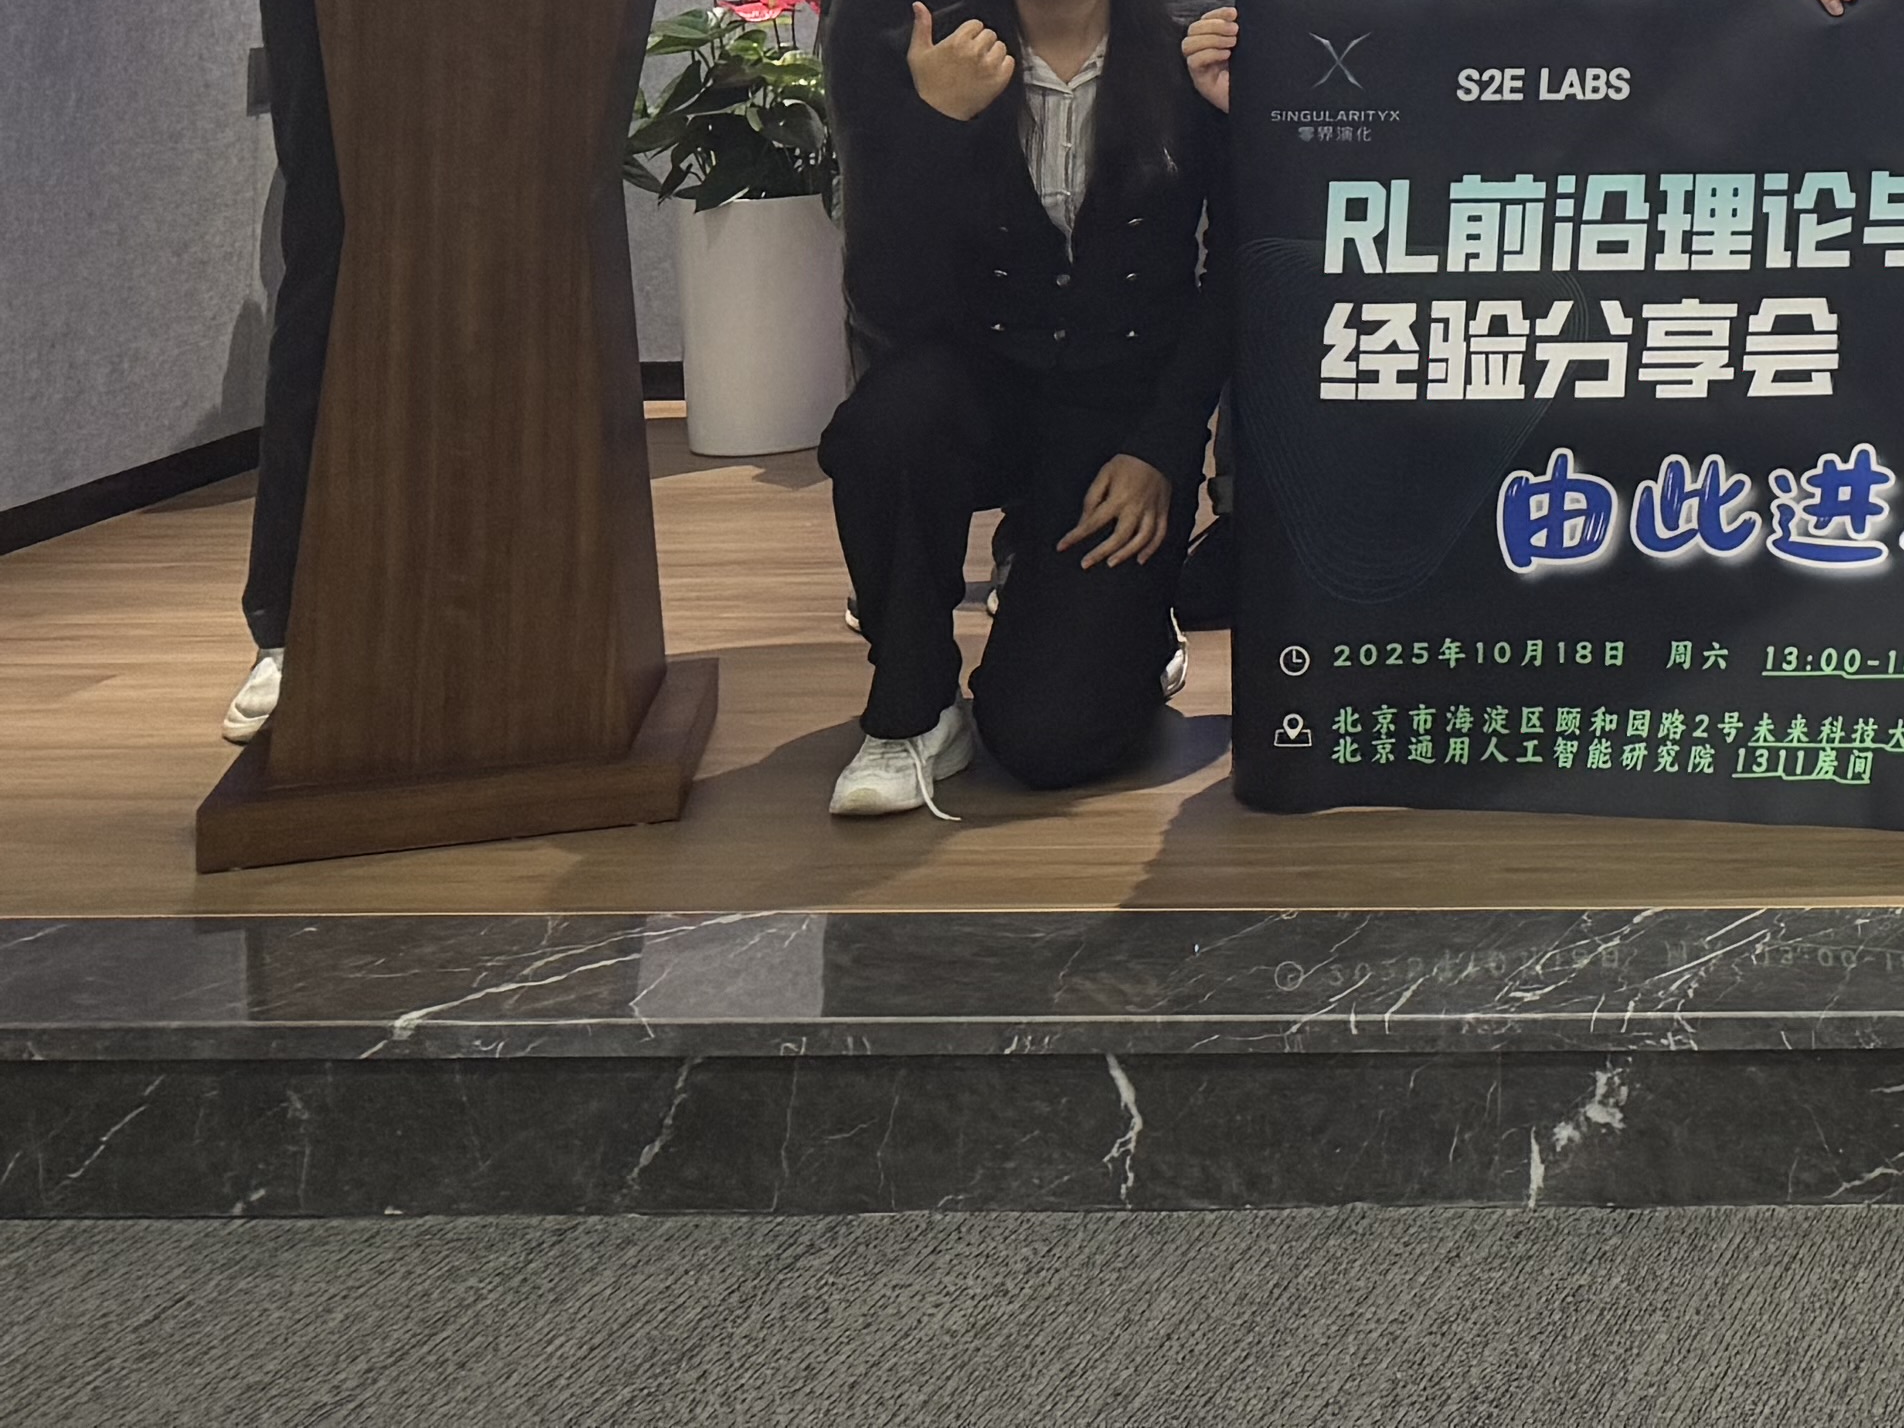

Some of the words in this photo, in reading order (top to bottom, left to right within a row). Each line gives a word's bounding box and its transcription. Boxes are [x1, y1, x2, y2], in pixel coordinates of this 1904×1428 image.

[1456, 67, 1525, 102] S2E
[1539, 67, 1632, 102] LABS
[1270, 110, 1400, 122] SINGULARITYX
[1319, 297, 1840, 401] 经验分享会
[1333, 637, 1625, 670] 2025年10月18日
[1665, 641, 1729, 671] 周六
